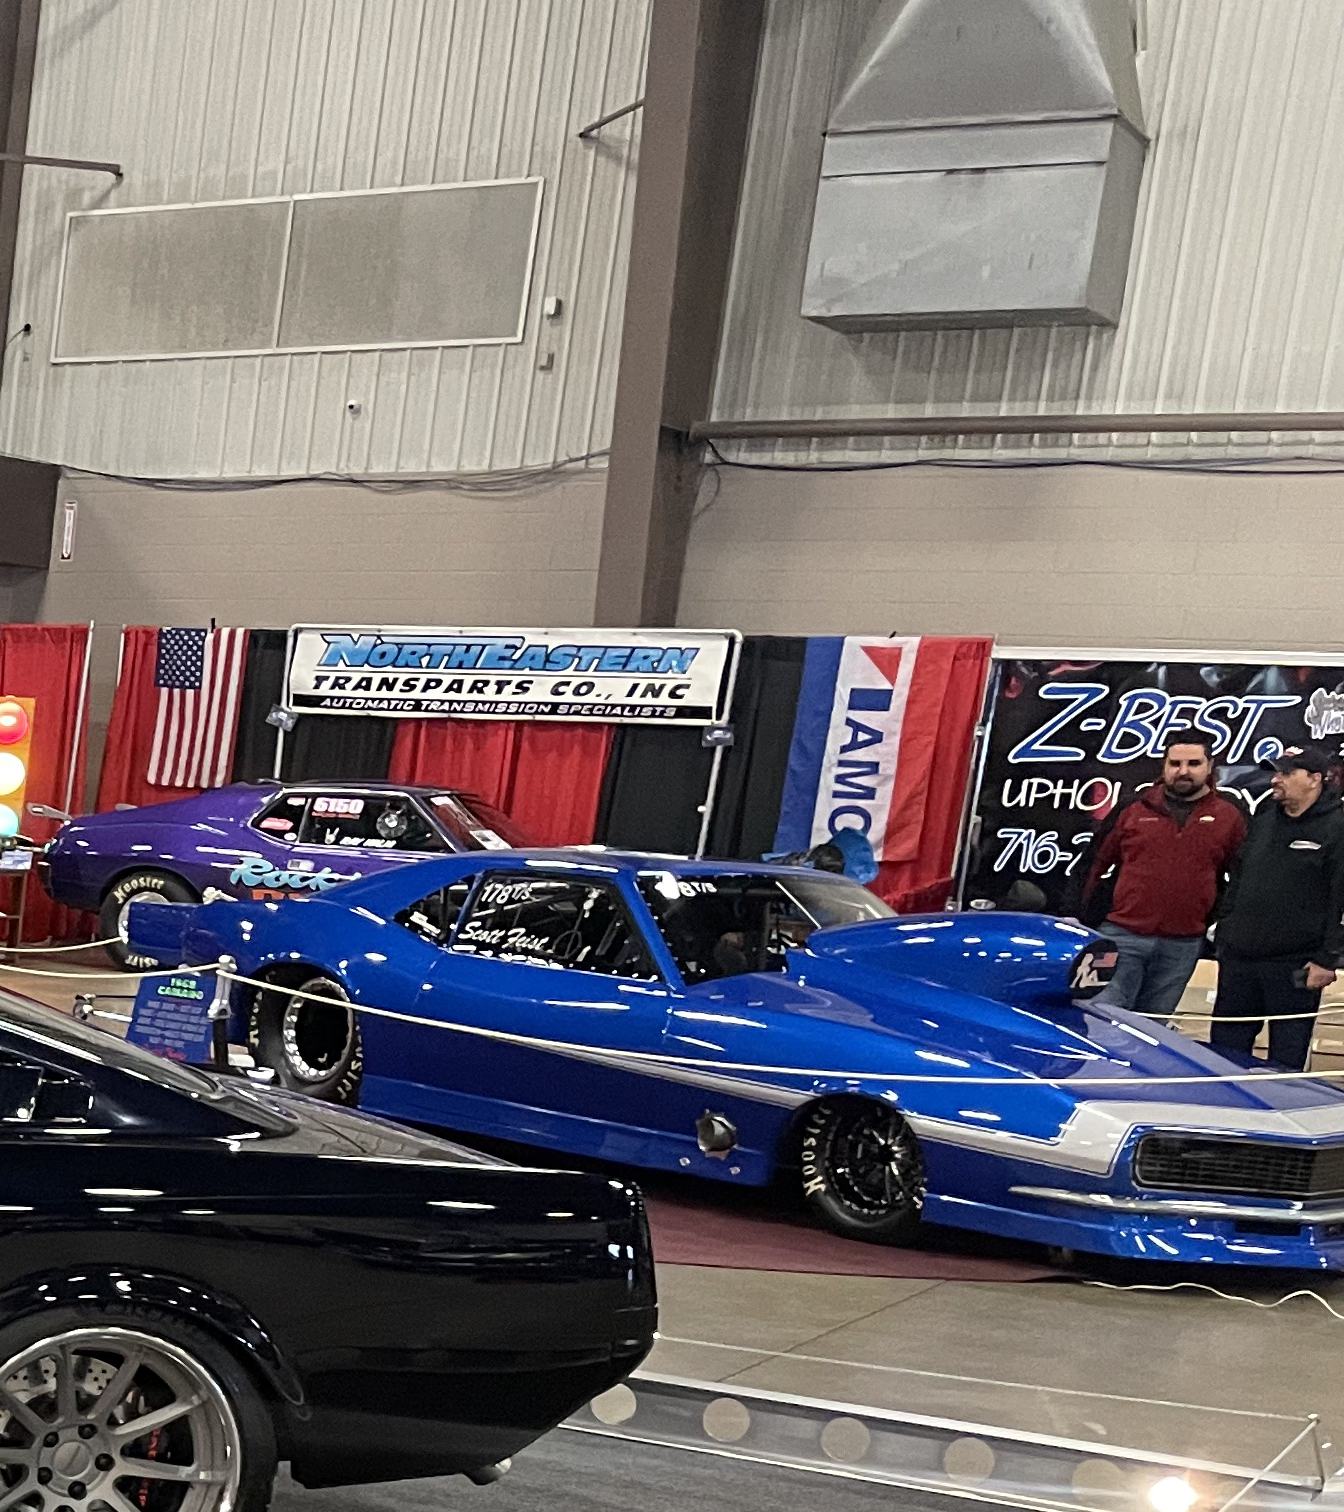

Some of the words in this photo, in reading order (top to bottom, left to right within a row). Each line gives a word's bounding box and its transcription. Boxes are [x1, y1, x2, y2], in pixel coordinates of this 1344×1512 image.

[312, 675, 534, 696] TRANSPARTS
[550, 680, 613, 701] CO.,
[625, 682, 692, 700] INC
[319, 697, 415, 711] AUTOMATIC
[419, 700, 552, 714] TRANSMISSION
[556, 703, 678, 718] SPECIALISTS
[313, 796, 366, 815] 5150
[458, 921, 506, 944] Scott
[502, 927, 552, 951] Feist
